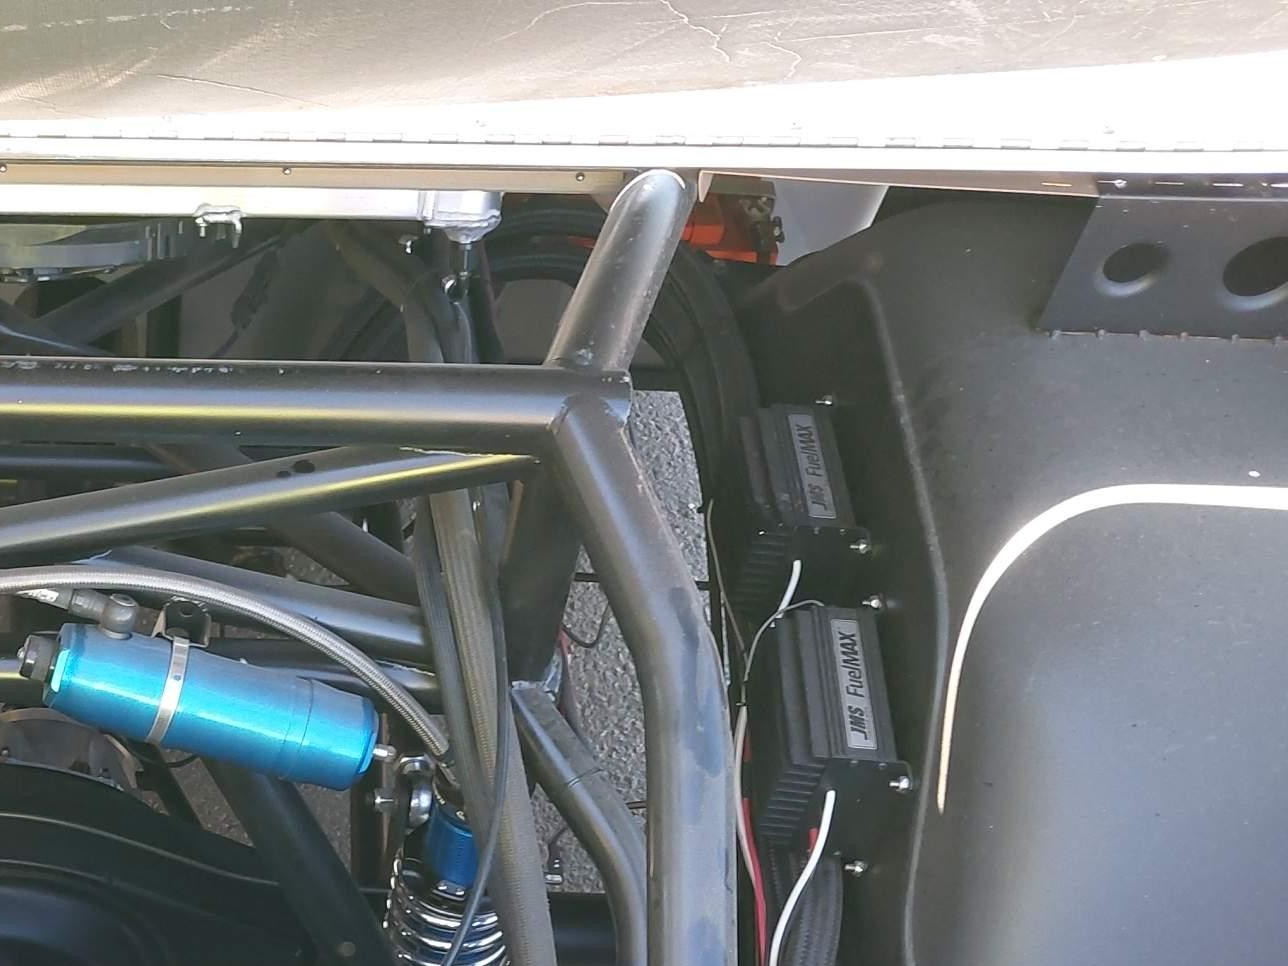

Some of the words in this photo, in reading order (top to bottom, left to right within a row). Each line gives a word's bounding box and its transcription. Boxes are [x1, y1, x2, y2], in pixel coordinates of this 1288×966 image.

[795, 424, 824, 478] FuelMAX
[838, 630, 865, 699] FuelMAX
[849, 705, 869, 740] JMS
